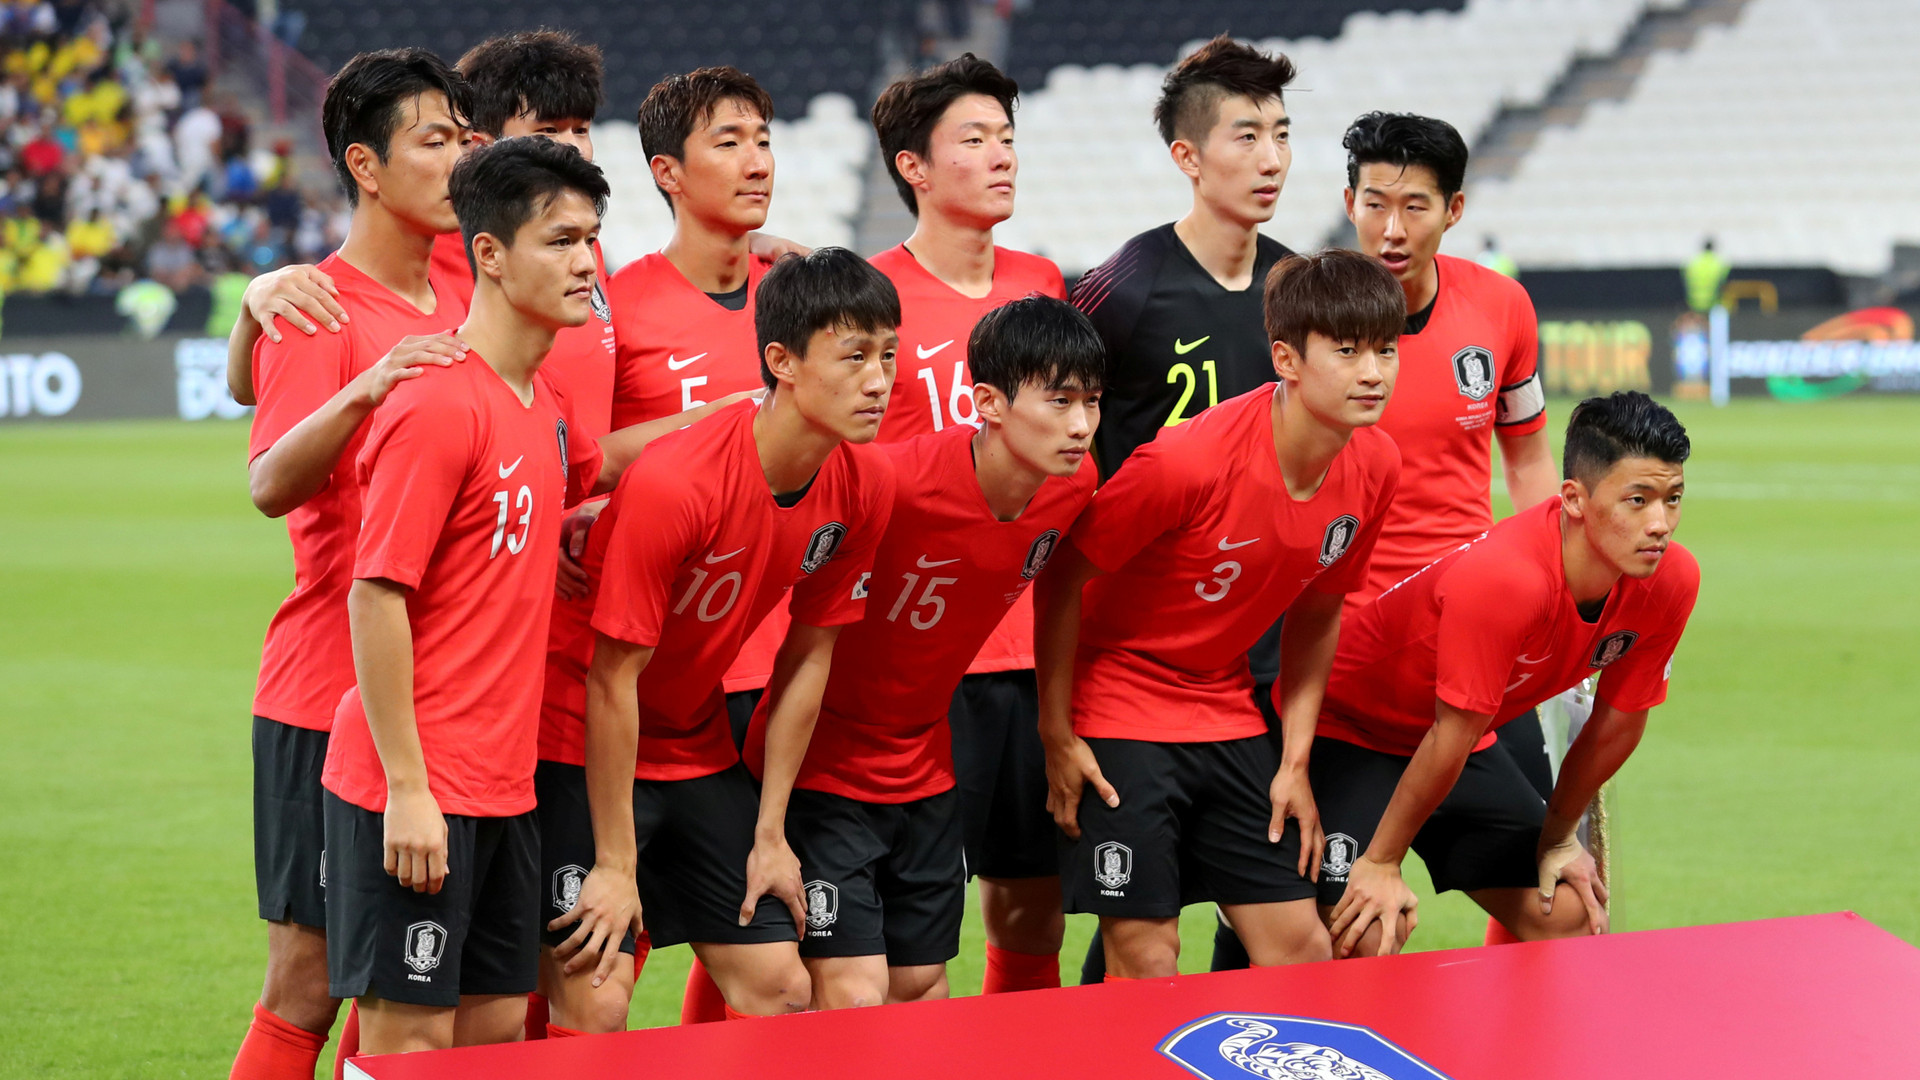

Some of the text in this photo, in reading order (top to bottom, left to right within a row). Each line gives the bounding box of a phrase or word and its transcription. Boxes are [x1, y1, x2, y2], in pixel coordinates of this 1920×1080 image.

[917, 361, 984, 432] 16
[1163, 360, 1218, 427] 21
[489, 485, 533, 559] 13
[672, 567, 742, 622] 10
[886, 572, 959, 630] 15
[1195, 561, 1242, 602] 3
[408, 973, 431, 982] KOREA
